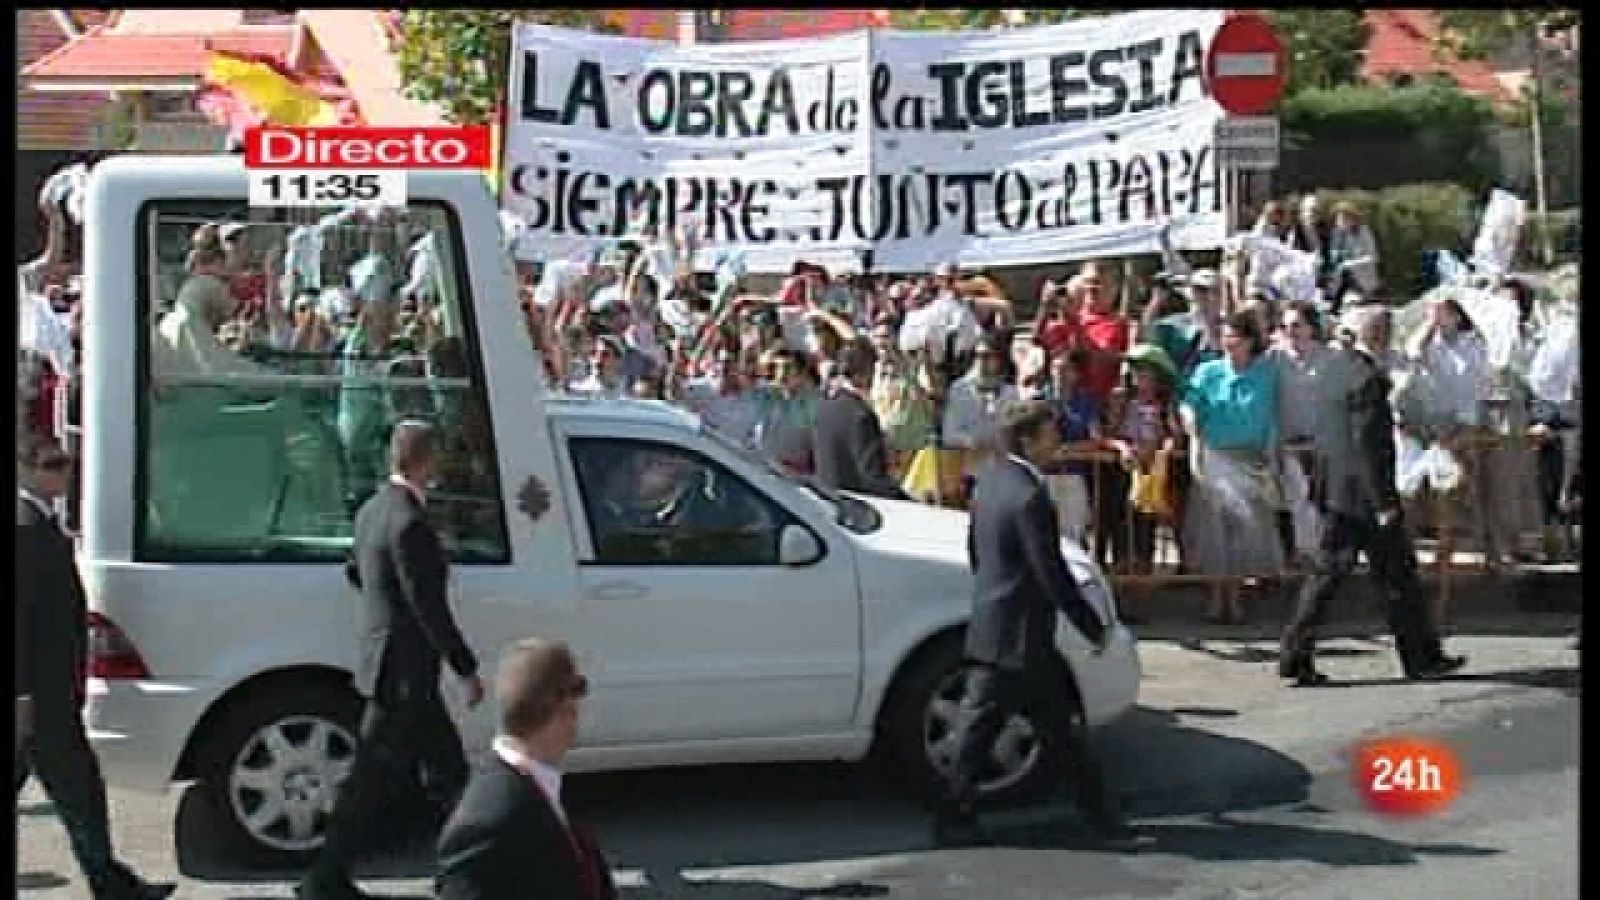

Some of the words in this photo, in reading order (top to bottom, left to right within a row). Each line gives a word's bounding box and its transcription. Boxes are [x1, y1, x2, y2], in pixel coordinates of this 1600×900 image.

[521, 50, 611, 129] LA
[637, 68, 801, 138] OBRA
[808, 64, 859, 132] de
[871, 62, 925, 130] la
[927, 30, 1203, 132] IGLESIA
[811, 168, 1032, 242] JUNTO
[1036, 161, 1079, 229] al
[1088, 146, 1222, 226] PAPA
